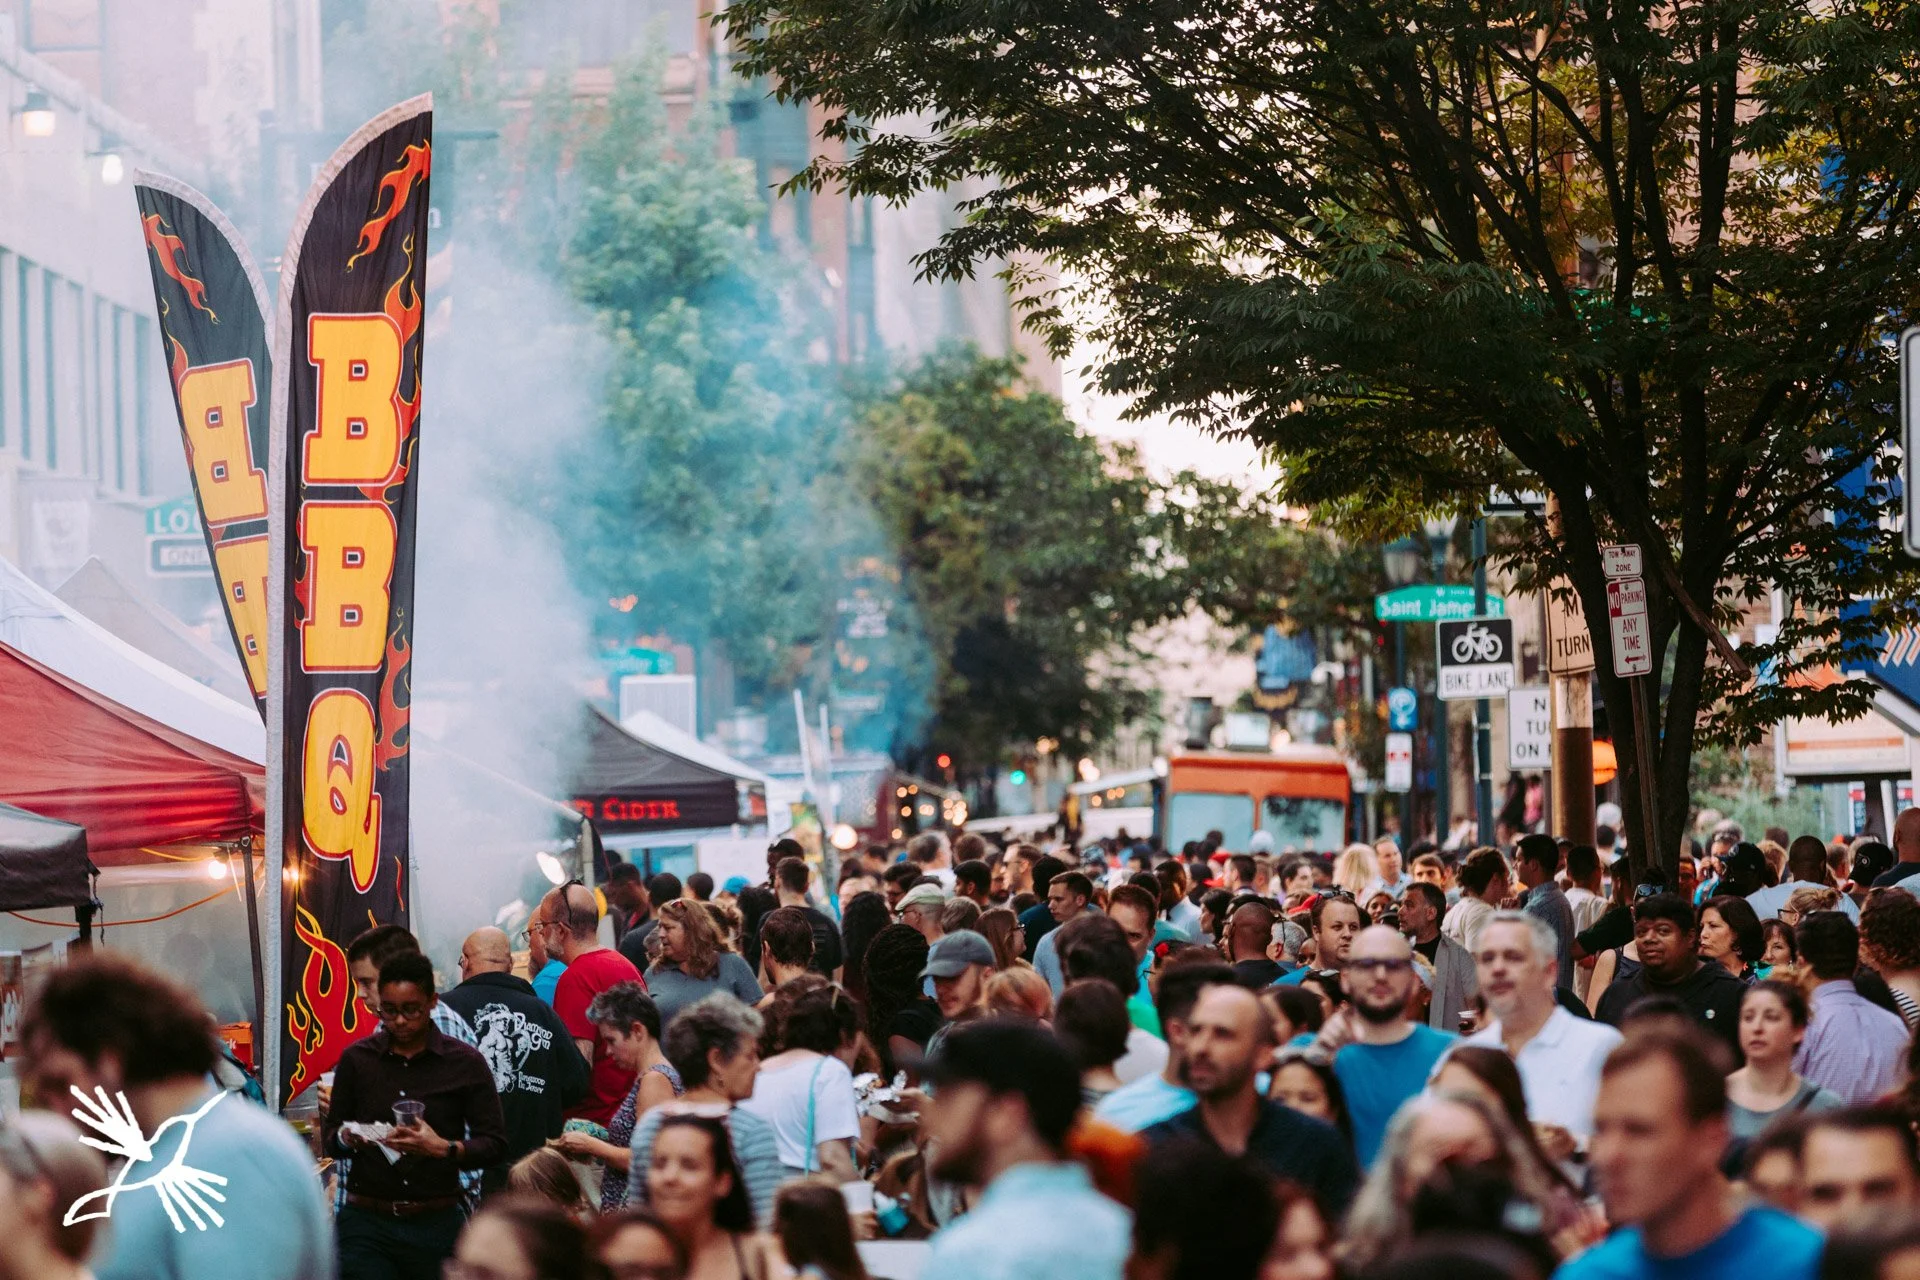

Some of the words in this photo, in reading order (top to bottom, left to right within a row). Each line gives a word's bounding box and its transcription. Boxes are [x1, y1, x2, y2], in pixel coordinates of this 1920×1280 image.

[1615, 564, 1632, 572] ZONE
[301, 311, 404, 894] BBQ
[1379, 595, 1421, 617] Saint
[1429, 599, 1476, 618] Jame
[1609, 592, 1620, 609] NO
[1621, 590, 1643, 604] PARKING
[1622, 618, 1637, 633] ANY
[1556, 634, 1590, 657] TURN
[1623, 635, 1641, 651] TIME
[1445, 671, 1471, 691] BIKE
[1478, 670, 1510, 689] LANE
[1516, 743, 1539, 758] ON
